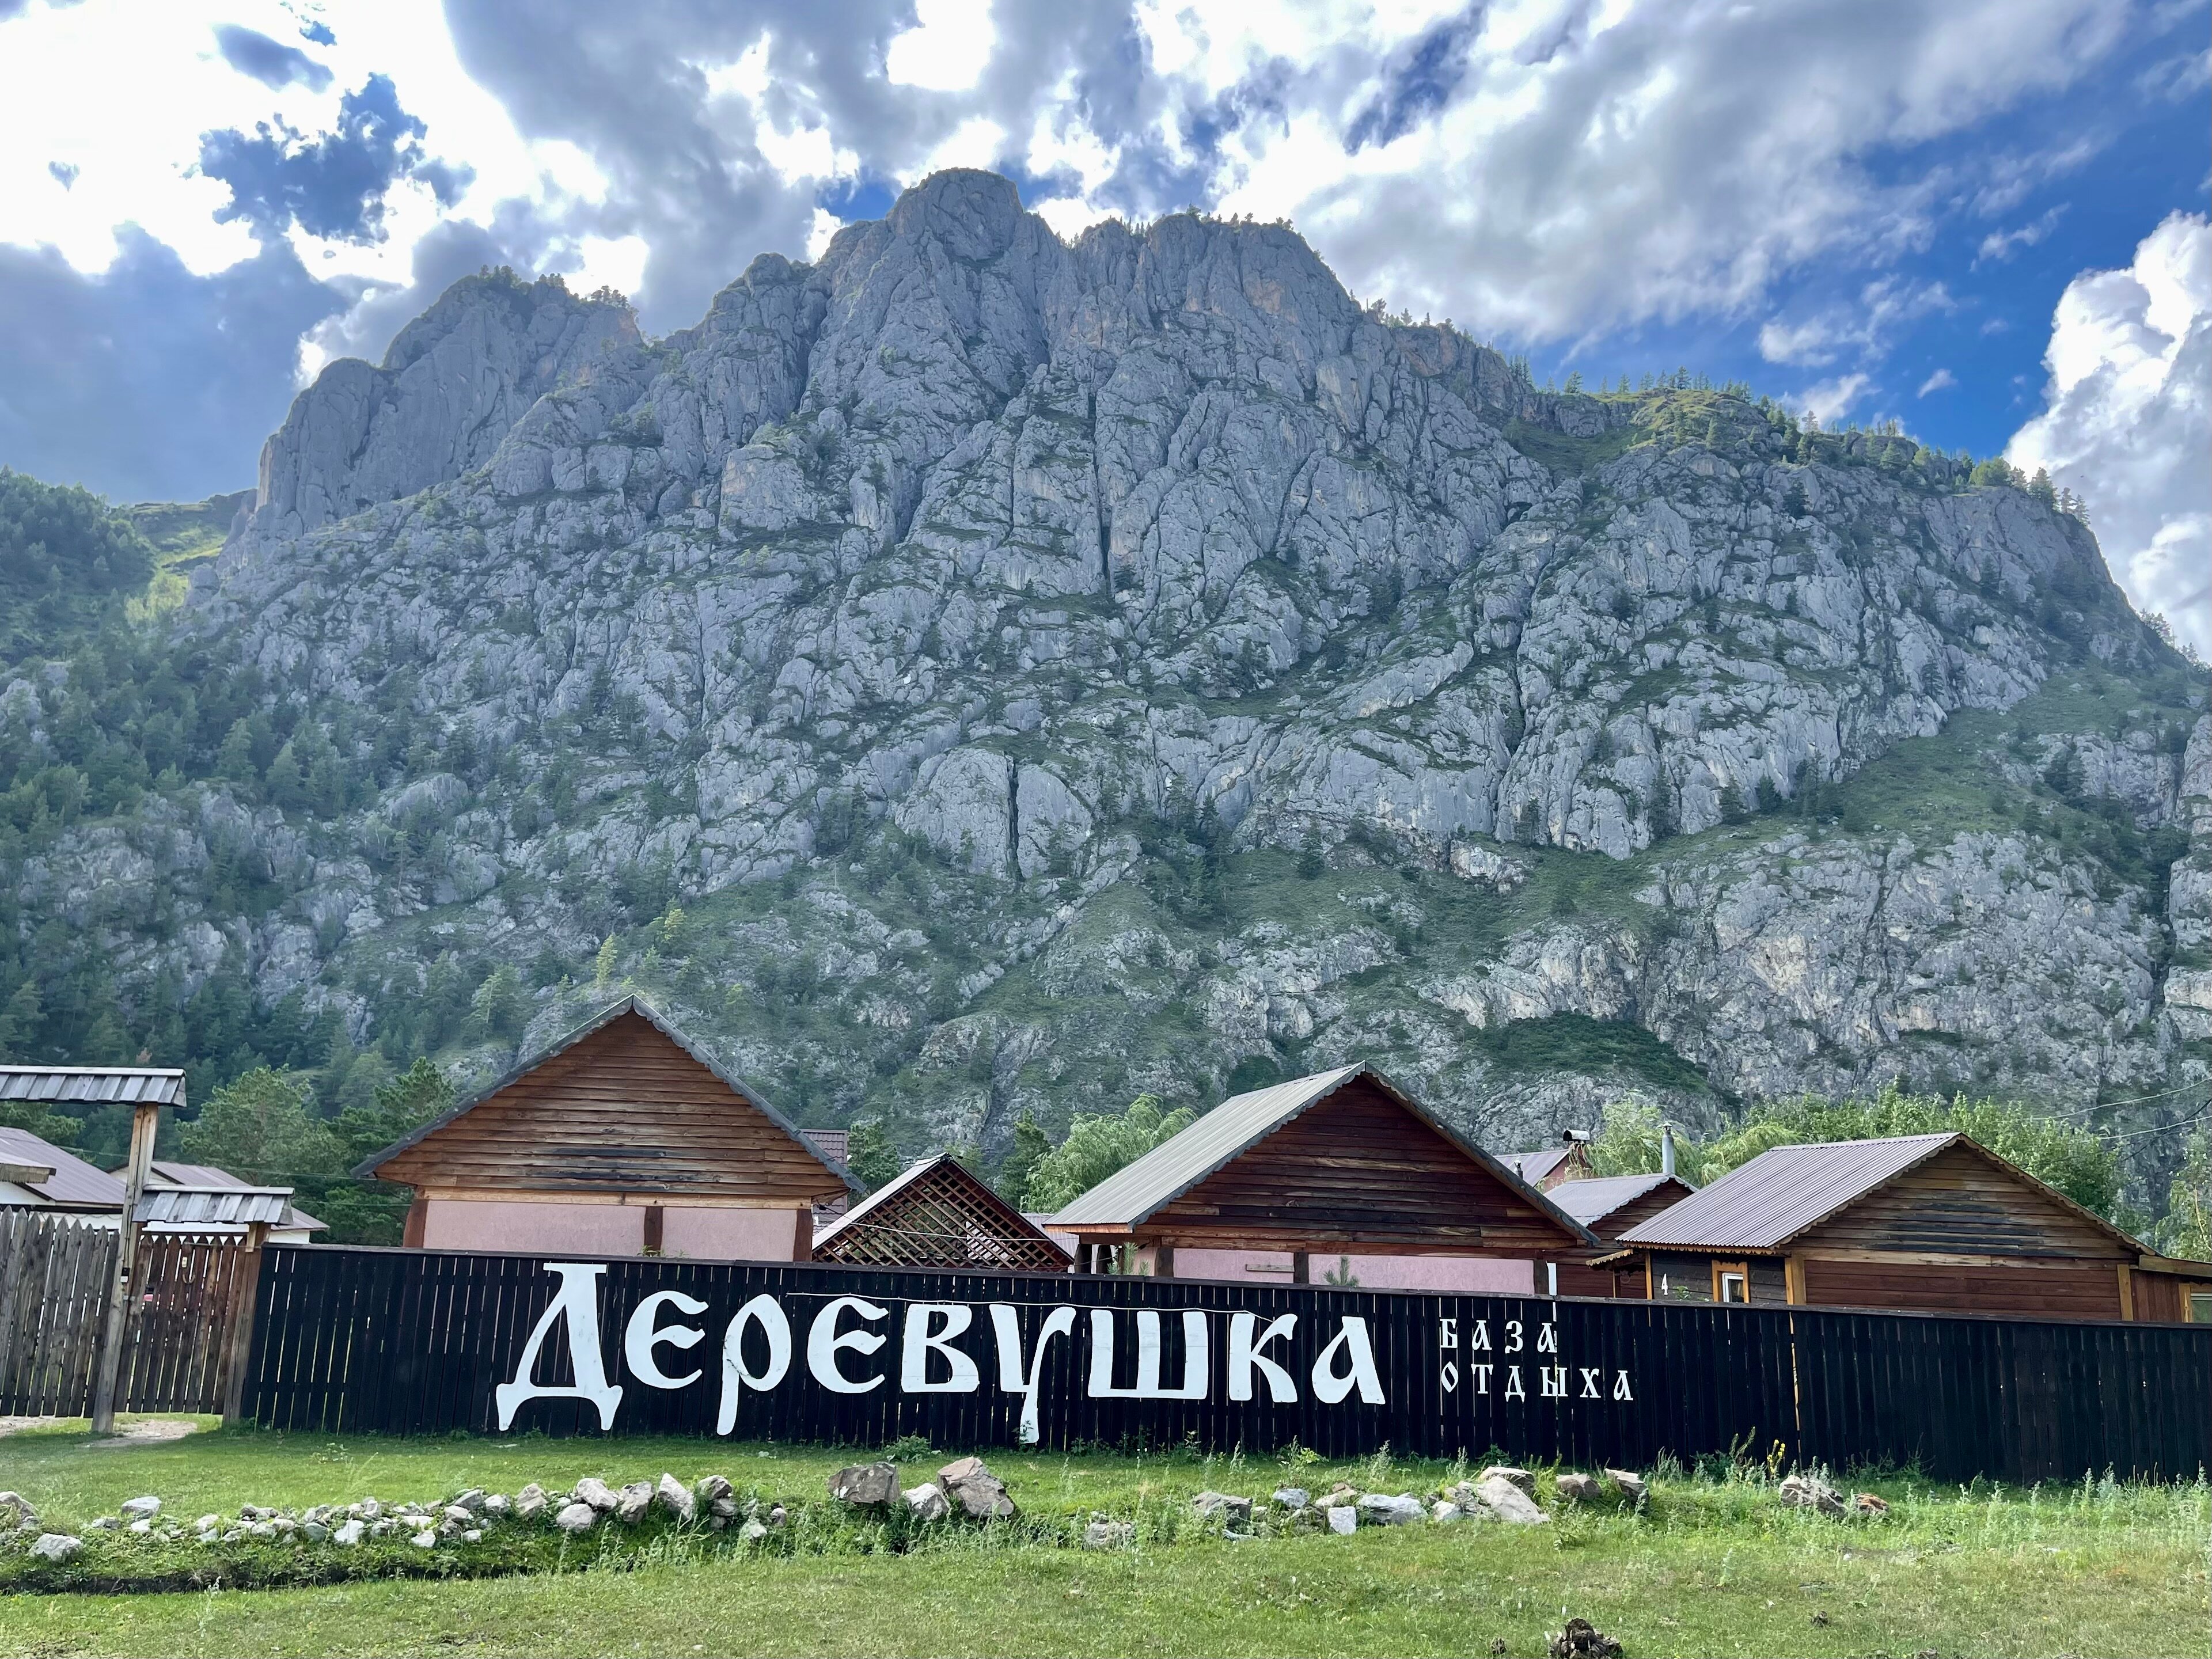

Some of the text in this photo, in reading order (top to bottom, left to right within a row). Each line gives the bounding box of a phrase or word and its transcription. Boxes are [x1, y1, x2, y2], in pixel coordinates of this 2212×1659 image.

[1661, 1273, 1668, 1295] 4
[1440, 1319, 1558, 1354] БАЗА
[1440, 1361, 1634, 1403] ОТДЫХА
